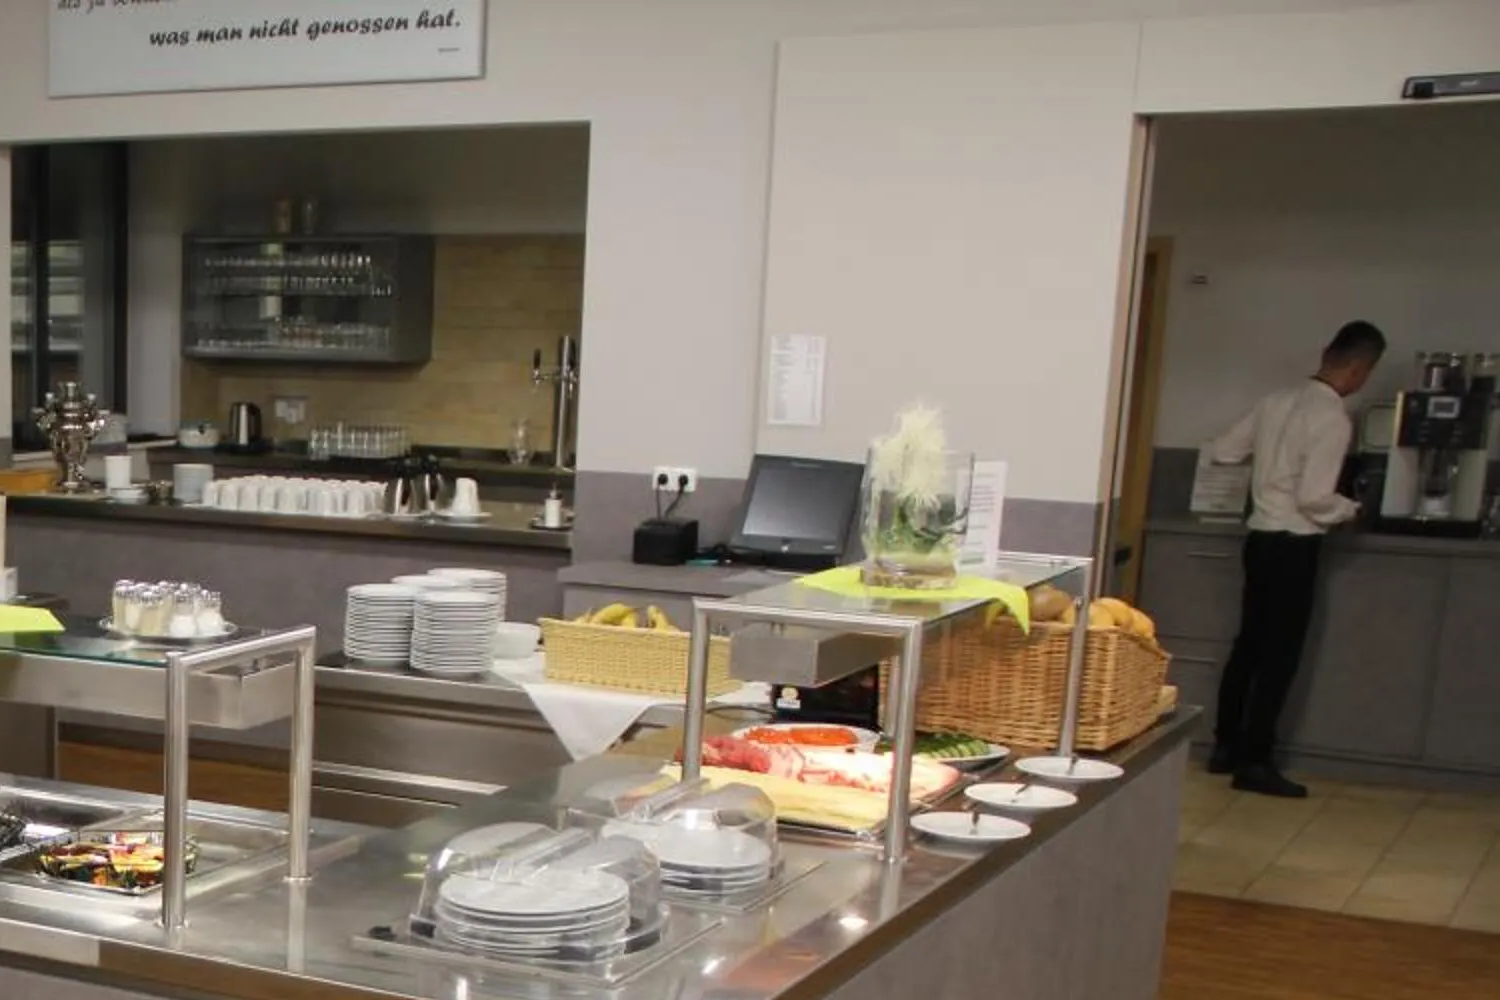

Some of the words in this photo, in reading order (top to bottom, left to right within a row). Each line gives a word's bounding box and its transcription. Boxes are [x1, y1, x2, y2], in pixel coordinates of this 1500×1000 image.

[149, 29, 190, 46] was
[196, 26, 243, 43] man
[249, 18, 300, 40] nicht
[306, 15, 409, 41] genossen
[415, 8, 461, 29] hat.
